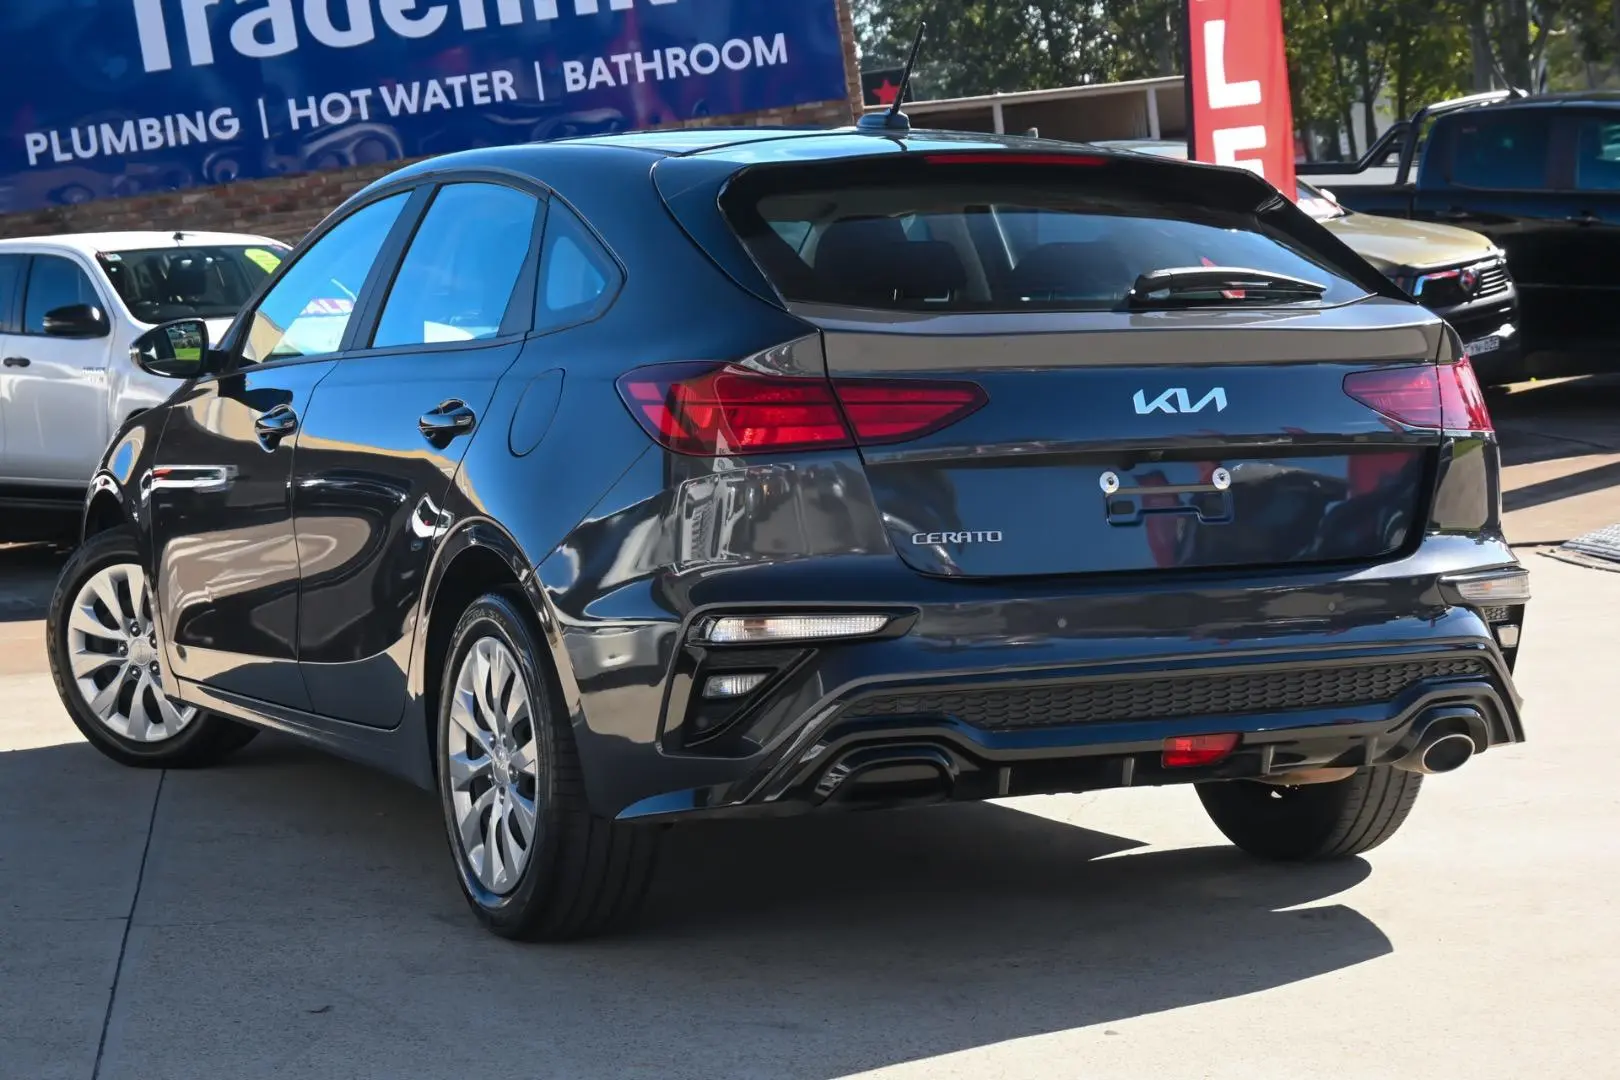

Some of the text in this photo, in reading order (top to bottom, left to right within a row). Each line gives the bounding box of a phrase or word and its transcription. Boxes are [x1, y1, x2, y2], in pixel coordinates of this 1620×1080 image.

[24, 32, 788, 166] PLUMBING HOT WATER BATHROOM
[1132, 387, 1228, 415] KIA
[912, 530, 1003, 545] CERATO
